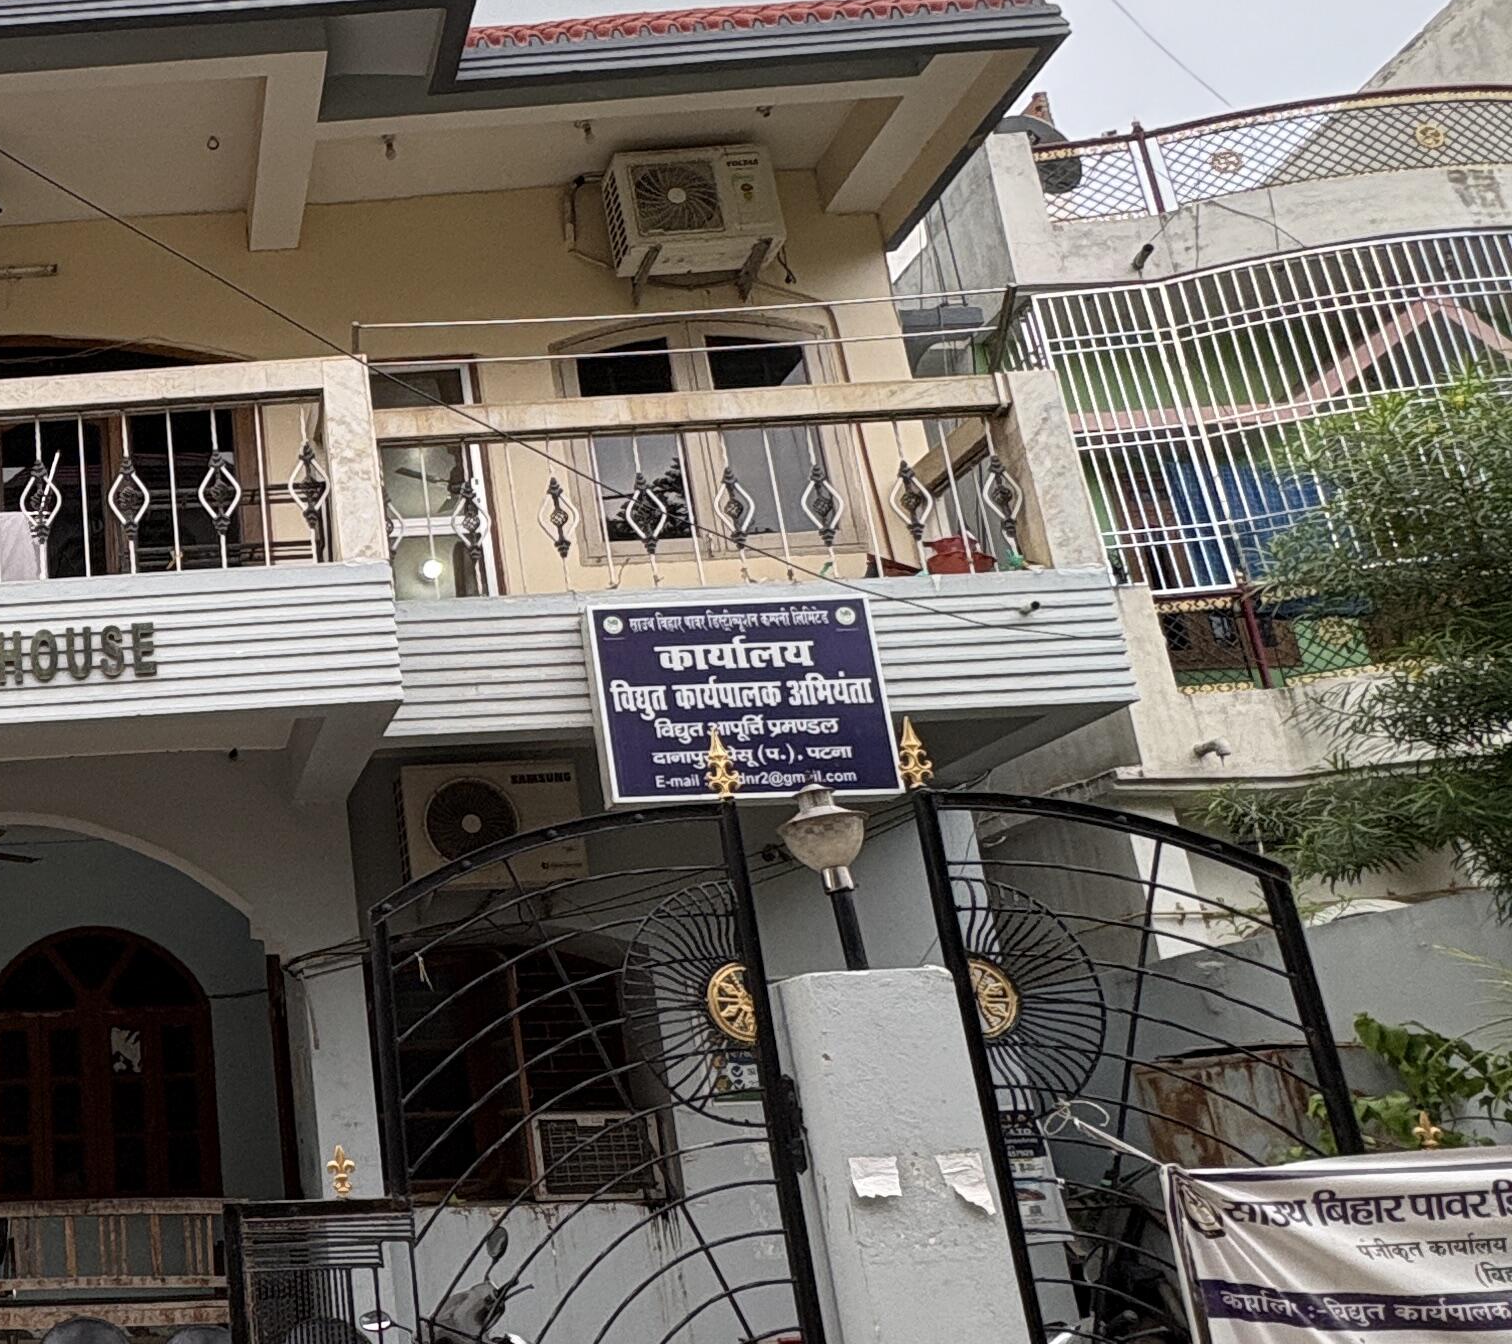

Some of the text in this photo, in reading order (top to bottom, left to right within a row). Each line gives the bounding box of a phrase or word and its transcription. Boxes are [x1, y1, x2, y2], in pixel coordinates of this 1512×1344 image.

[656, 611, 685, 632] बिहार
[685, 615, 708, 631] पावर
[654, 636, 814, 670] कार्यालय
[610, 671, 874, 720] विद्युत कार्यपालक अभियंता
[654, 719, 703, 744] विद्युत
[767, 717, 839, 738] प्रमण्डल
[807, 746, 853, 760] पटना
[511, 772, 571, 784] SAMSUNG
[655, 775, 700, 788] E-mail
[1223, 1199, 1313, 1227] साउथ
[1312, 1189, 1406, 1227] बिहार
[1407, 1189, 1492, 1220] पावर
[1356, 1232, 1507, 1263] पंजीकृत कार्यालय
[1393, 1297, 1512, 1323] कार्यपालक
